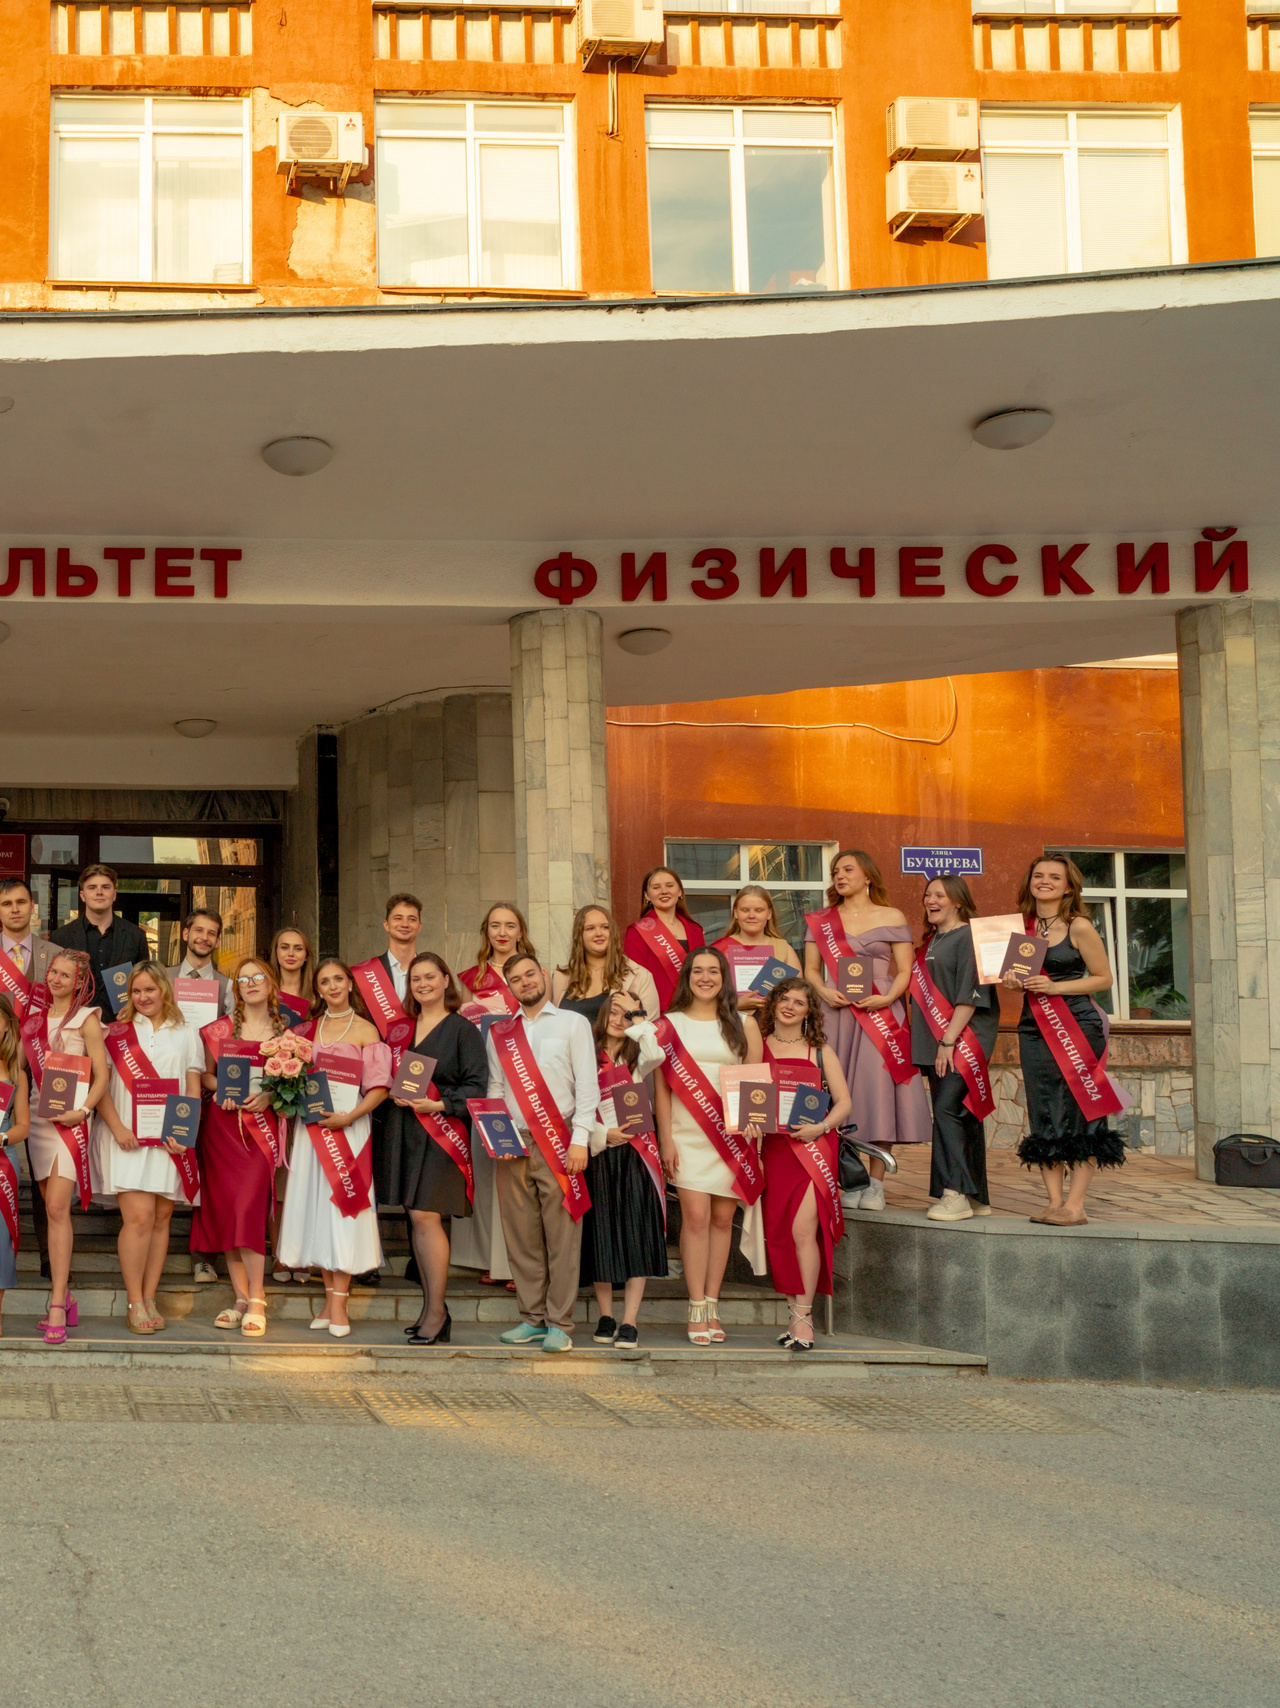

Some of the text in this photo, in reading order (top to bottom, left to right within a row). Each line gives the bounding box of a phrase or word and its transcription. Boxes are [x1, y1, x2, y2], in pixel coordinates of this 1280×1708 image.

[533, 527, 1249, 604] ФИЗИЧЕСКИЙ
[906, 857, 979, 869] БУКИРЕВА
[654, 934, 683, 972] ЛУЧШИ
[821, 922, 843, 962] ЛУЧШИ
[364, 970, 397, 1020] ЛУЧШИЙ
[32, 1037, 45, 1070] ЛУЧШ
[117, 1039, 145, 1079] ЛУЧШИ
[887, 1039, 906, 1065] 2024
[930, 1006, 980, 1075] ВЫПСКНИК
[975, 1075, 987, 1101] 2024
[1037, 995, 1103, 1101] ВЫПУСКНИК 2024
[430, 1111, 470, 1161] ПУСКНИК
[505, 1038, 582, 1200] ЛУЧШИЙ ВЫПУСКНИ 2024
[663, 1042, 756, 1186] ЛУЧШИЙ ВЫПУСКНИК 2024
[183, 1159, 194, 1184] 2024
[321, 1128, 356, 1198] СКНИК 2024
[804, 1141, 836, 1197] УСКНИК
